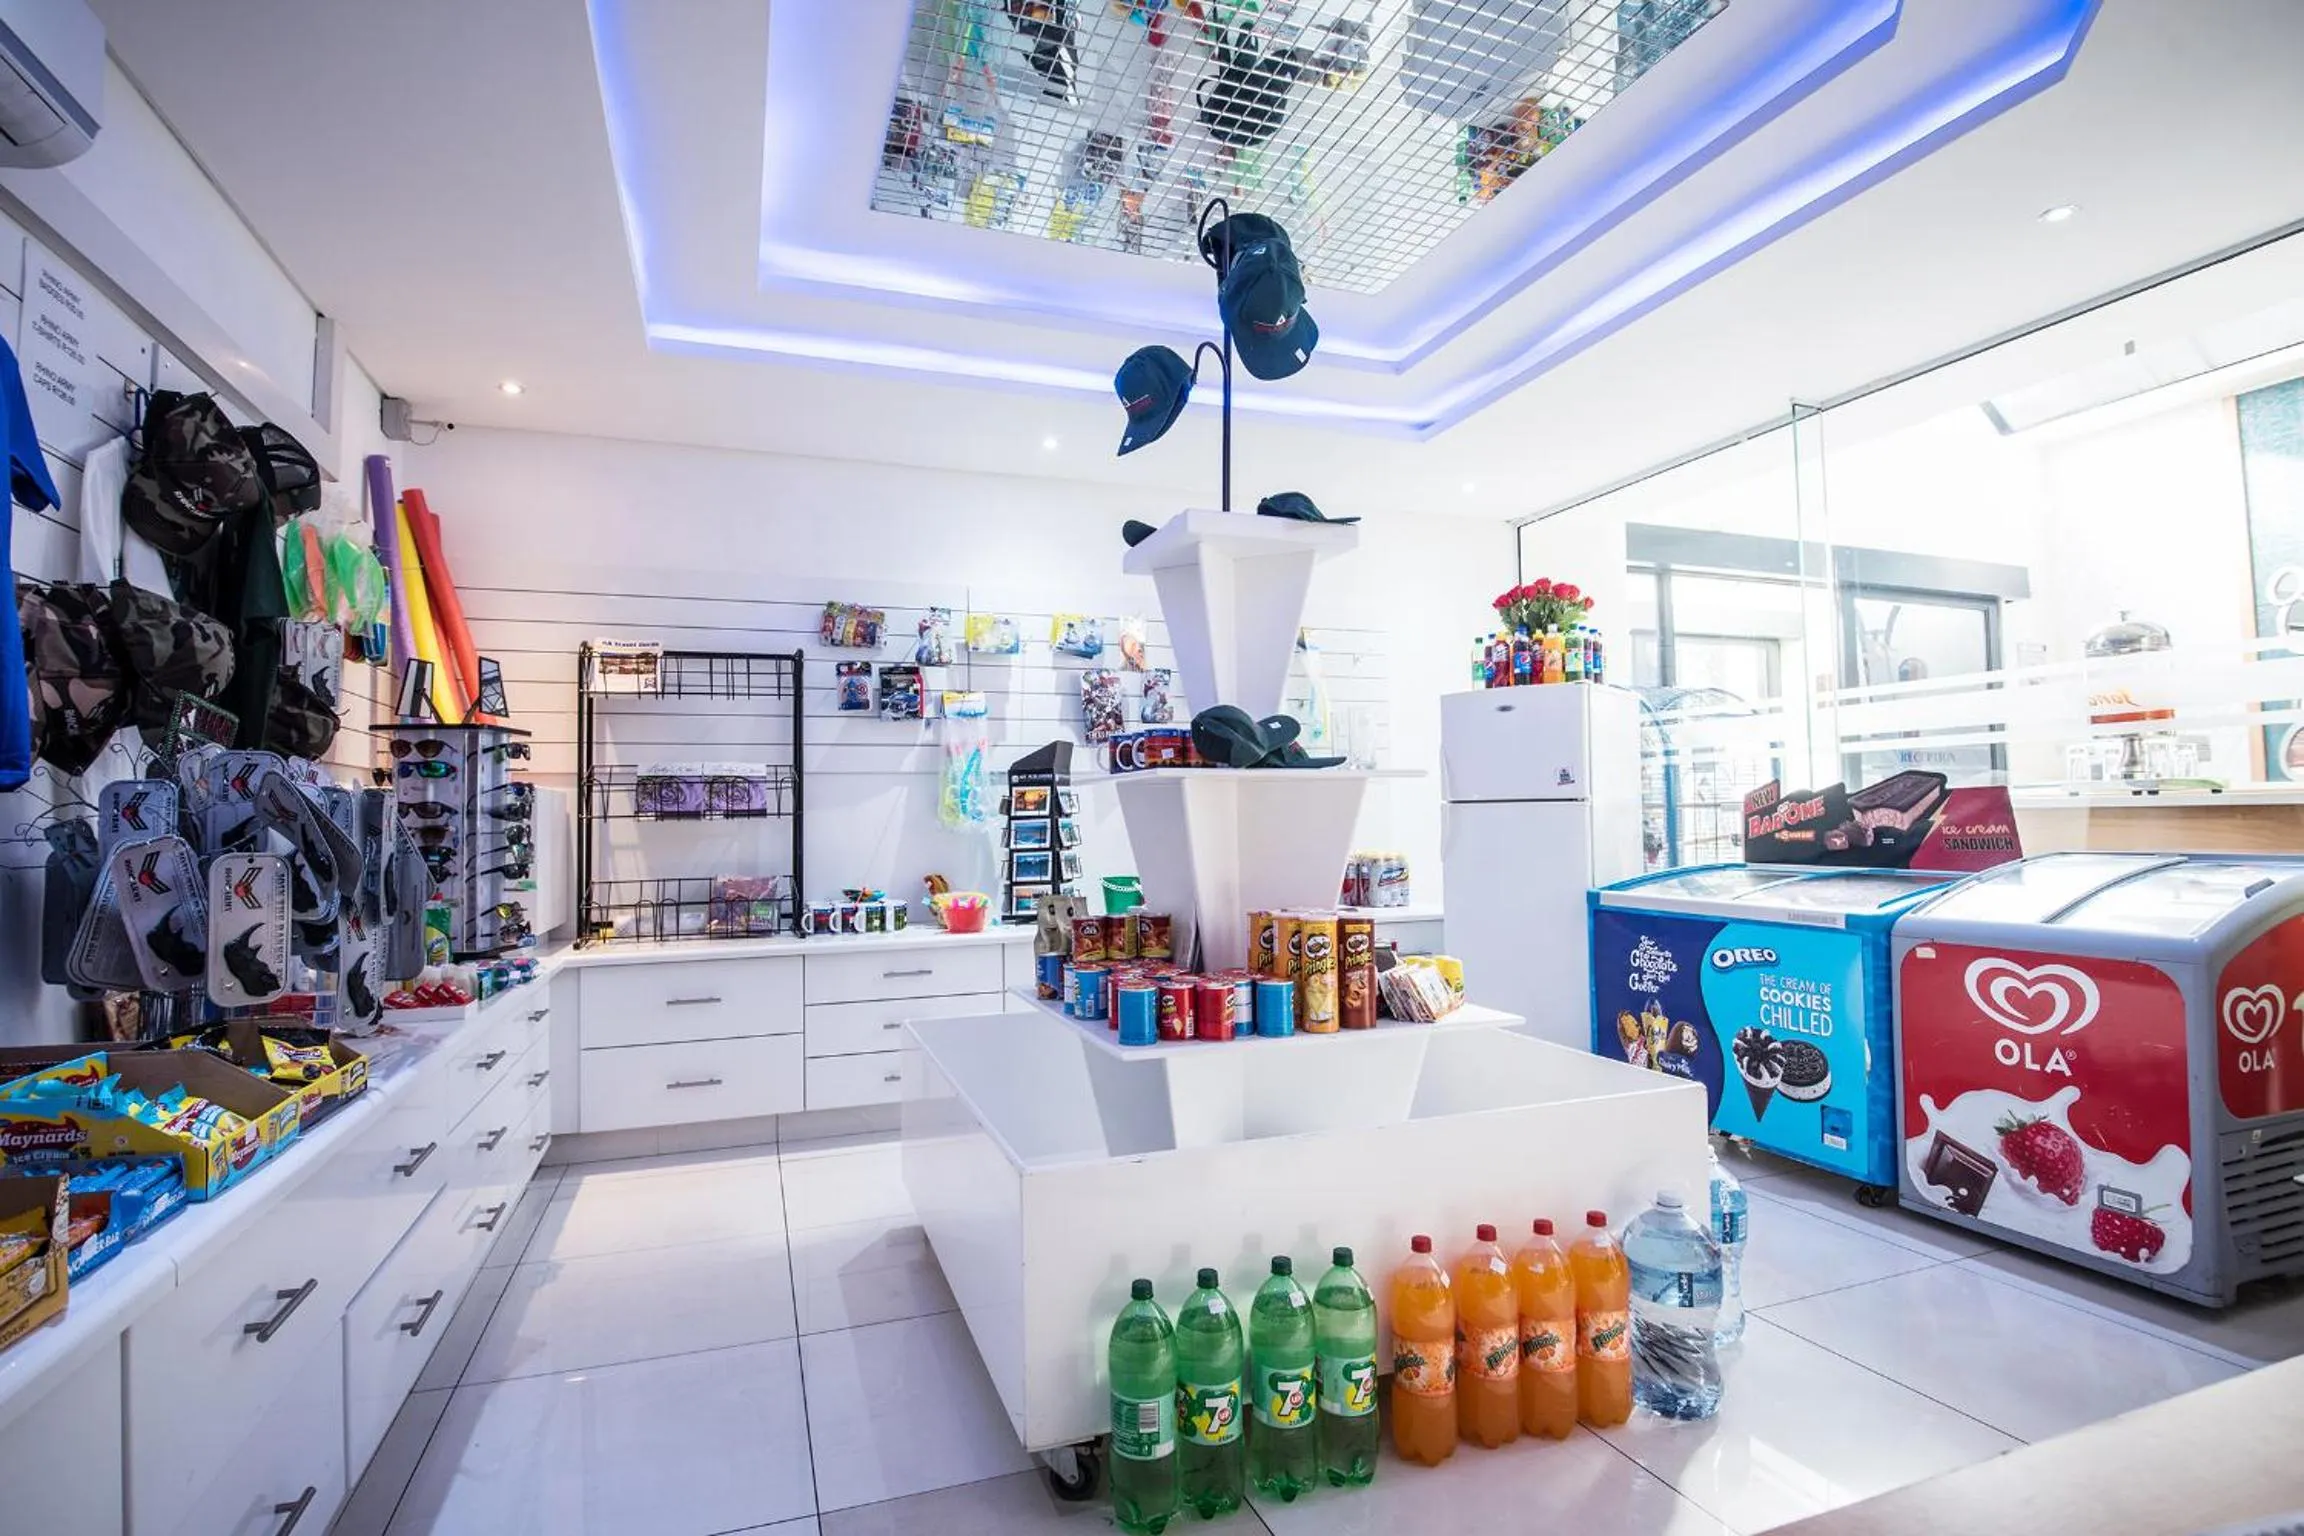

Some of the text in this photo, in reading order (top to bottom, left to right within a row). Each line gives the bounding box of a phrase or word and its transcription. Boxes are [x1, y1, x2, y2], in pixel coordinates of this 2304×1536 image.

[1941, 823, 2010, 835] ice cream
[1943, 837, 2015, 851] SANDWICH
[1712, 948, 1777, 968] OREO
[1760, 973, 1831, 995] THE CREAM OF
[1760, 987, 1831, 1012] COOKIES
[1760, 1003, 1833, 1037] CHILLED
[2239, 1049, 2275, 1073] OLA
